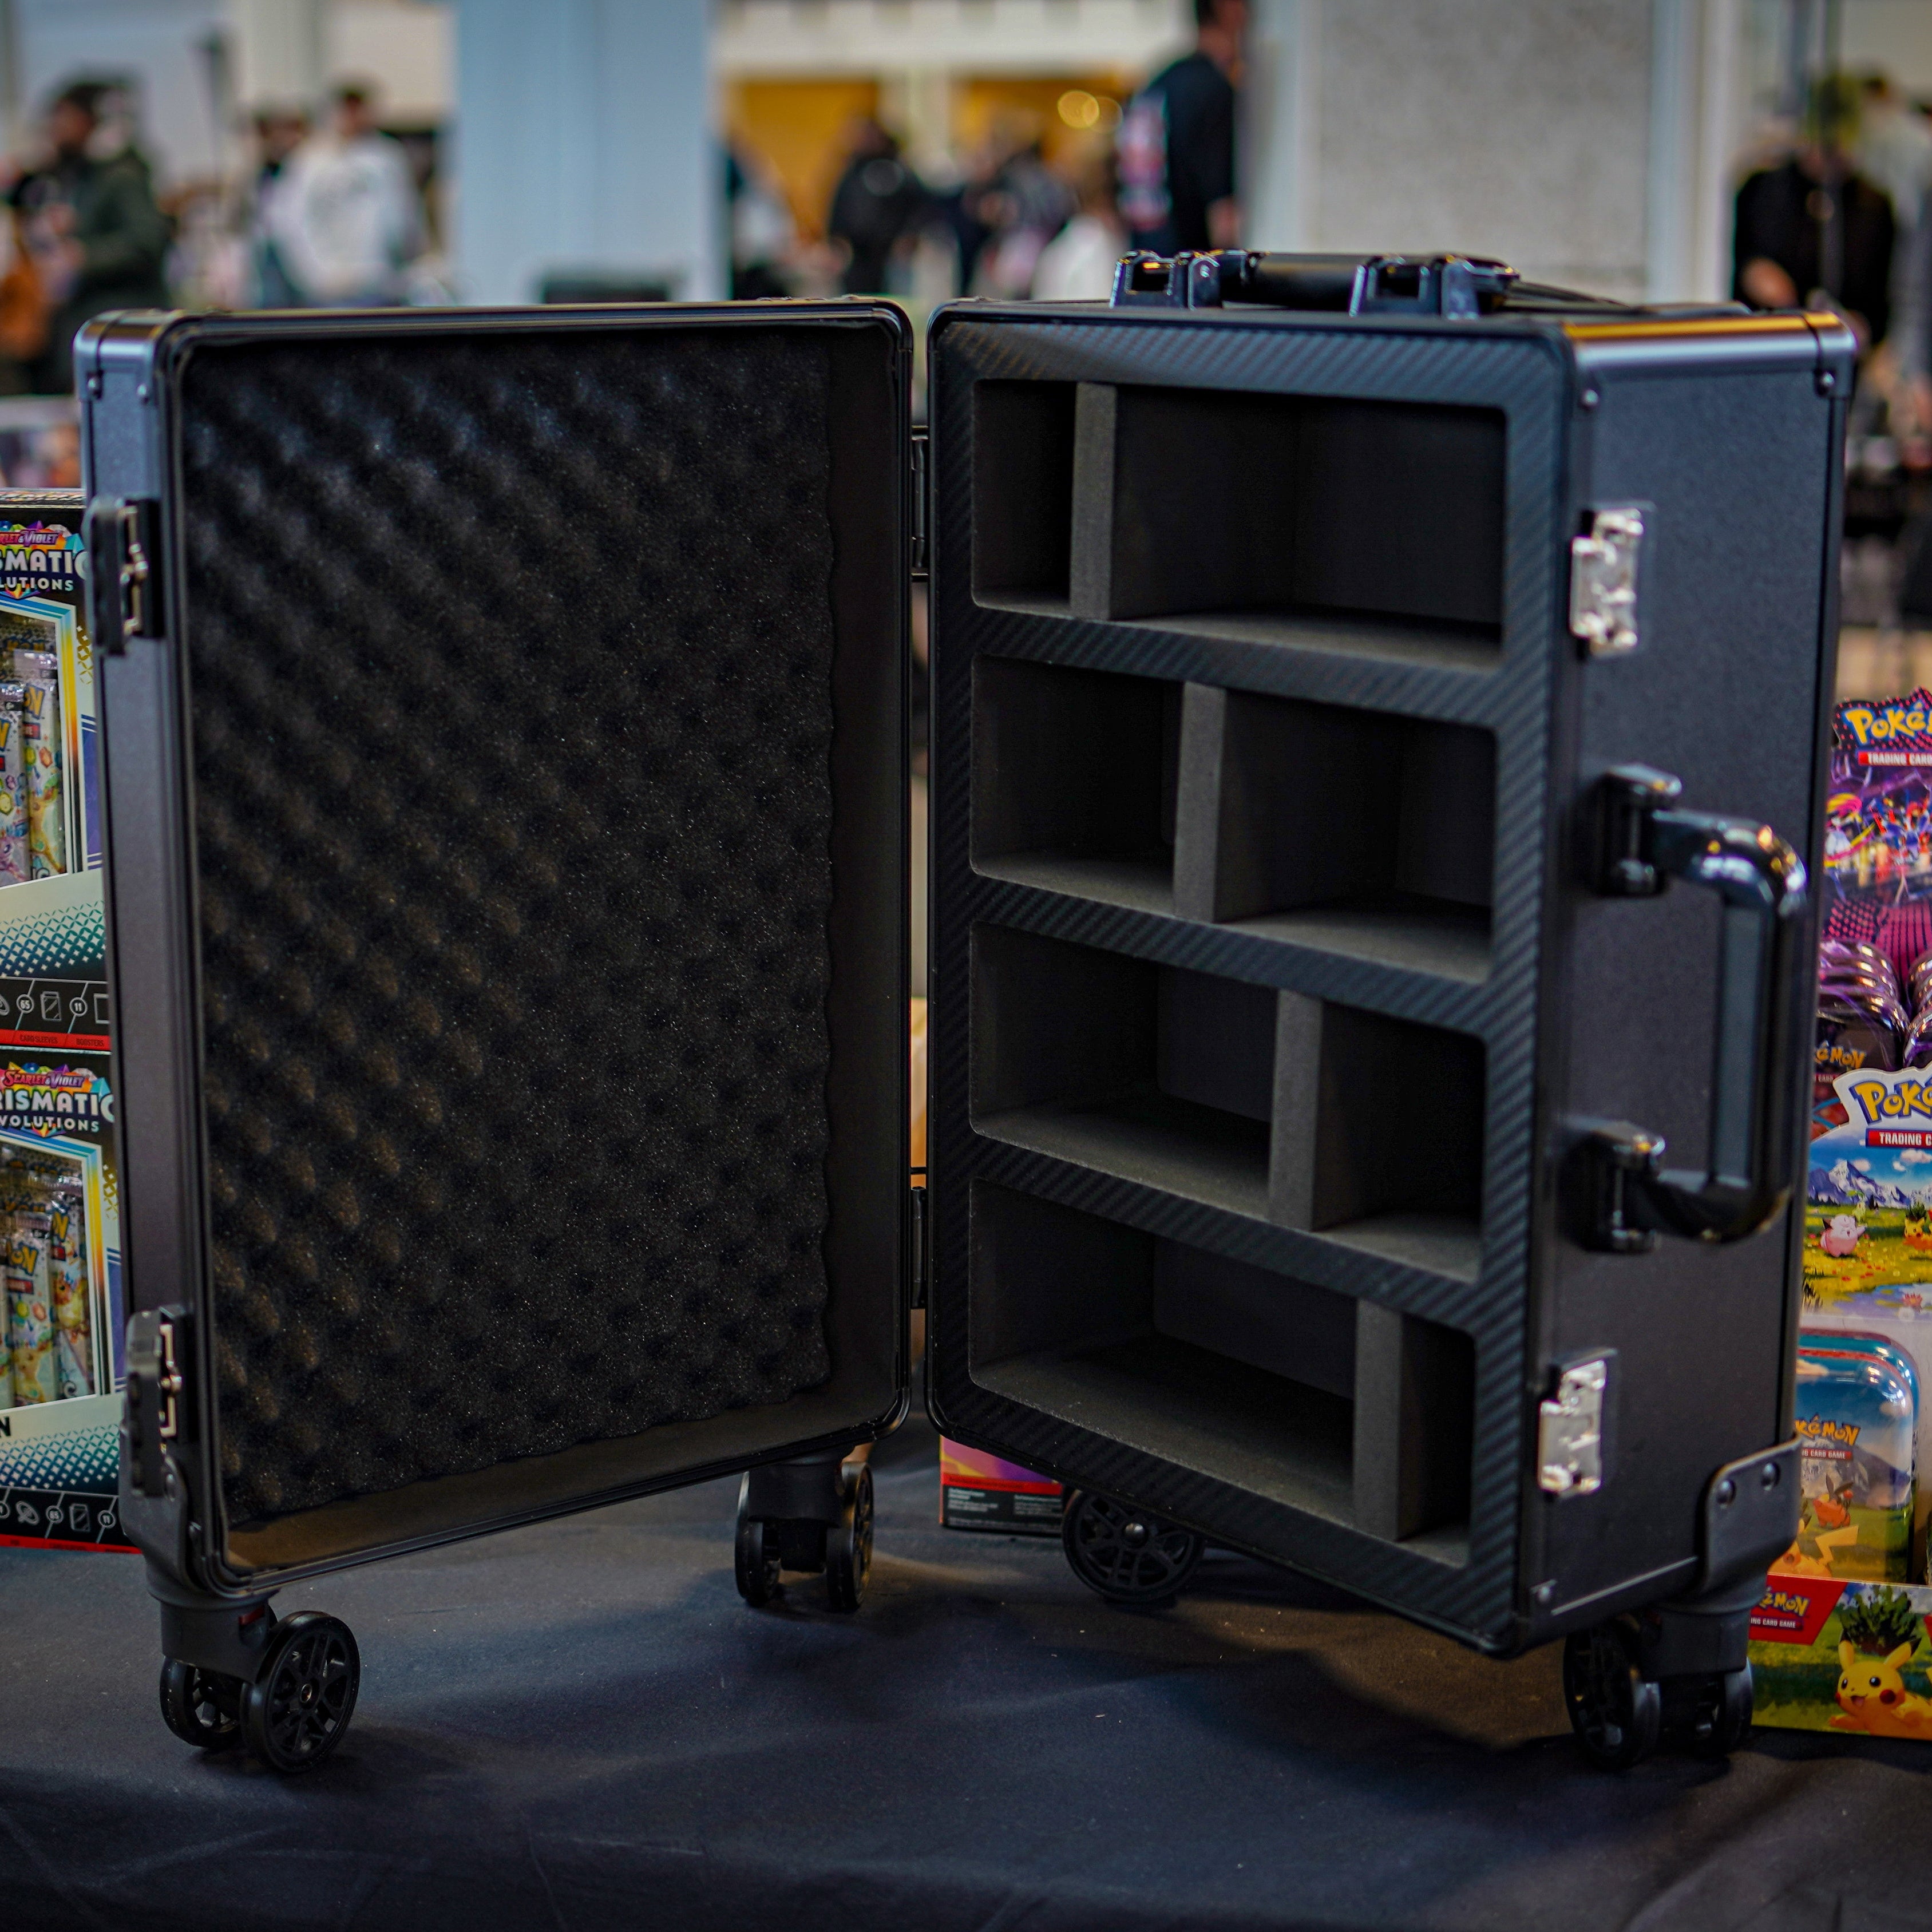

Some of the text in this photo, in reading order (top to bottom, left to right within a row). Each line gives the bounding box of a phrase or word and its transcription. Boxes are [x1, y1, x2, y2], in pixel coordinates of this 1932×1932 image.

[0, 549, 89, 580] MATIC
[1867, 752, 1907, 765] TRADING
[76, 1038, 104, 1047] BOOSTERS
[3, 1069, 47, 1086] SCARLET
[47, 1071, 85, 1088] VIOLET
[0, 1088, 115, 1123] ISMATIC
[1879, 1131, 1922, 1146] TRADING
[1810, 1448, 1826, 1458] CARD
[1828, 1450, 1846, 1459] GAME
[1763, 1618, 1778, 1627] CARD
[1779, 1620, 1796, 1629] GAME
